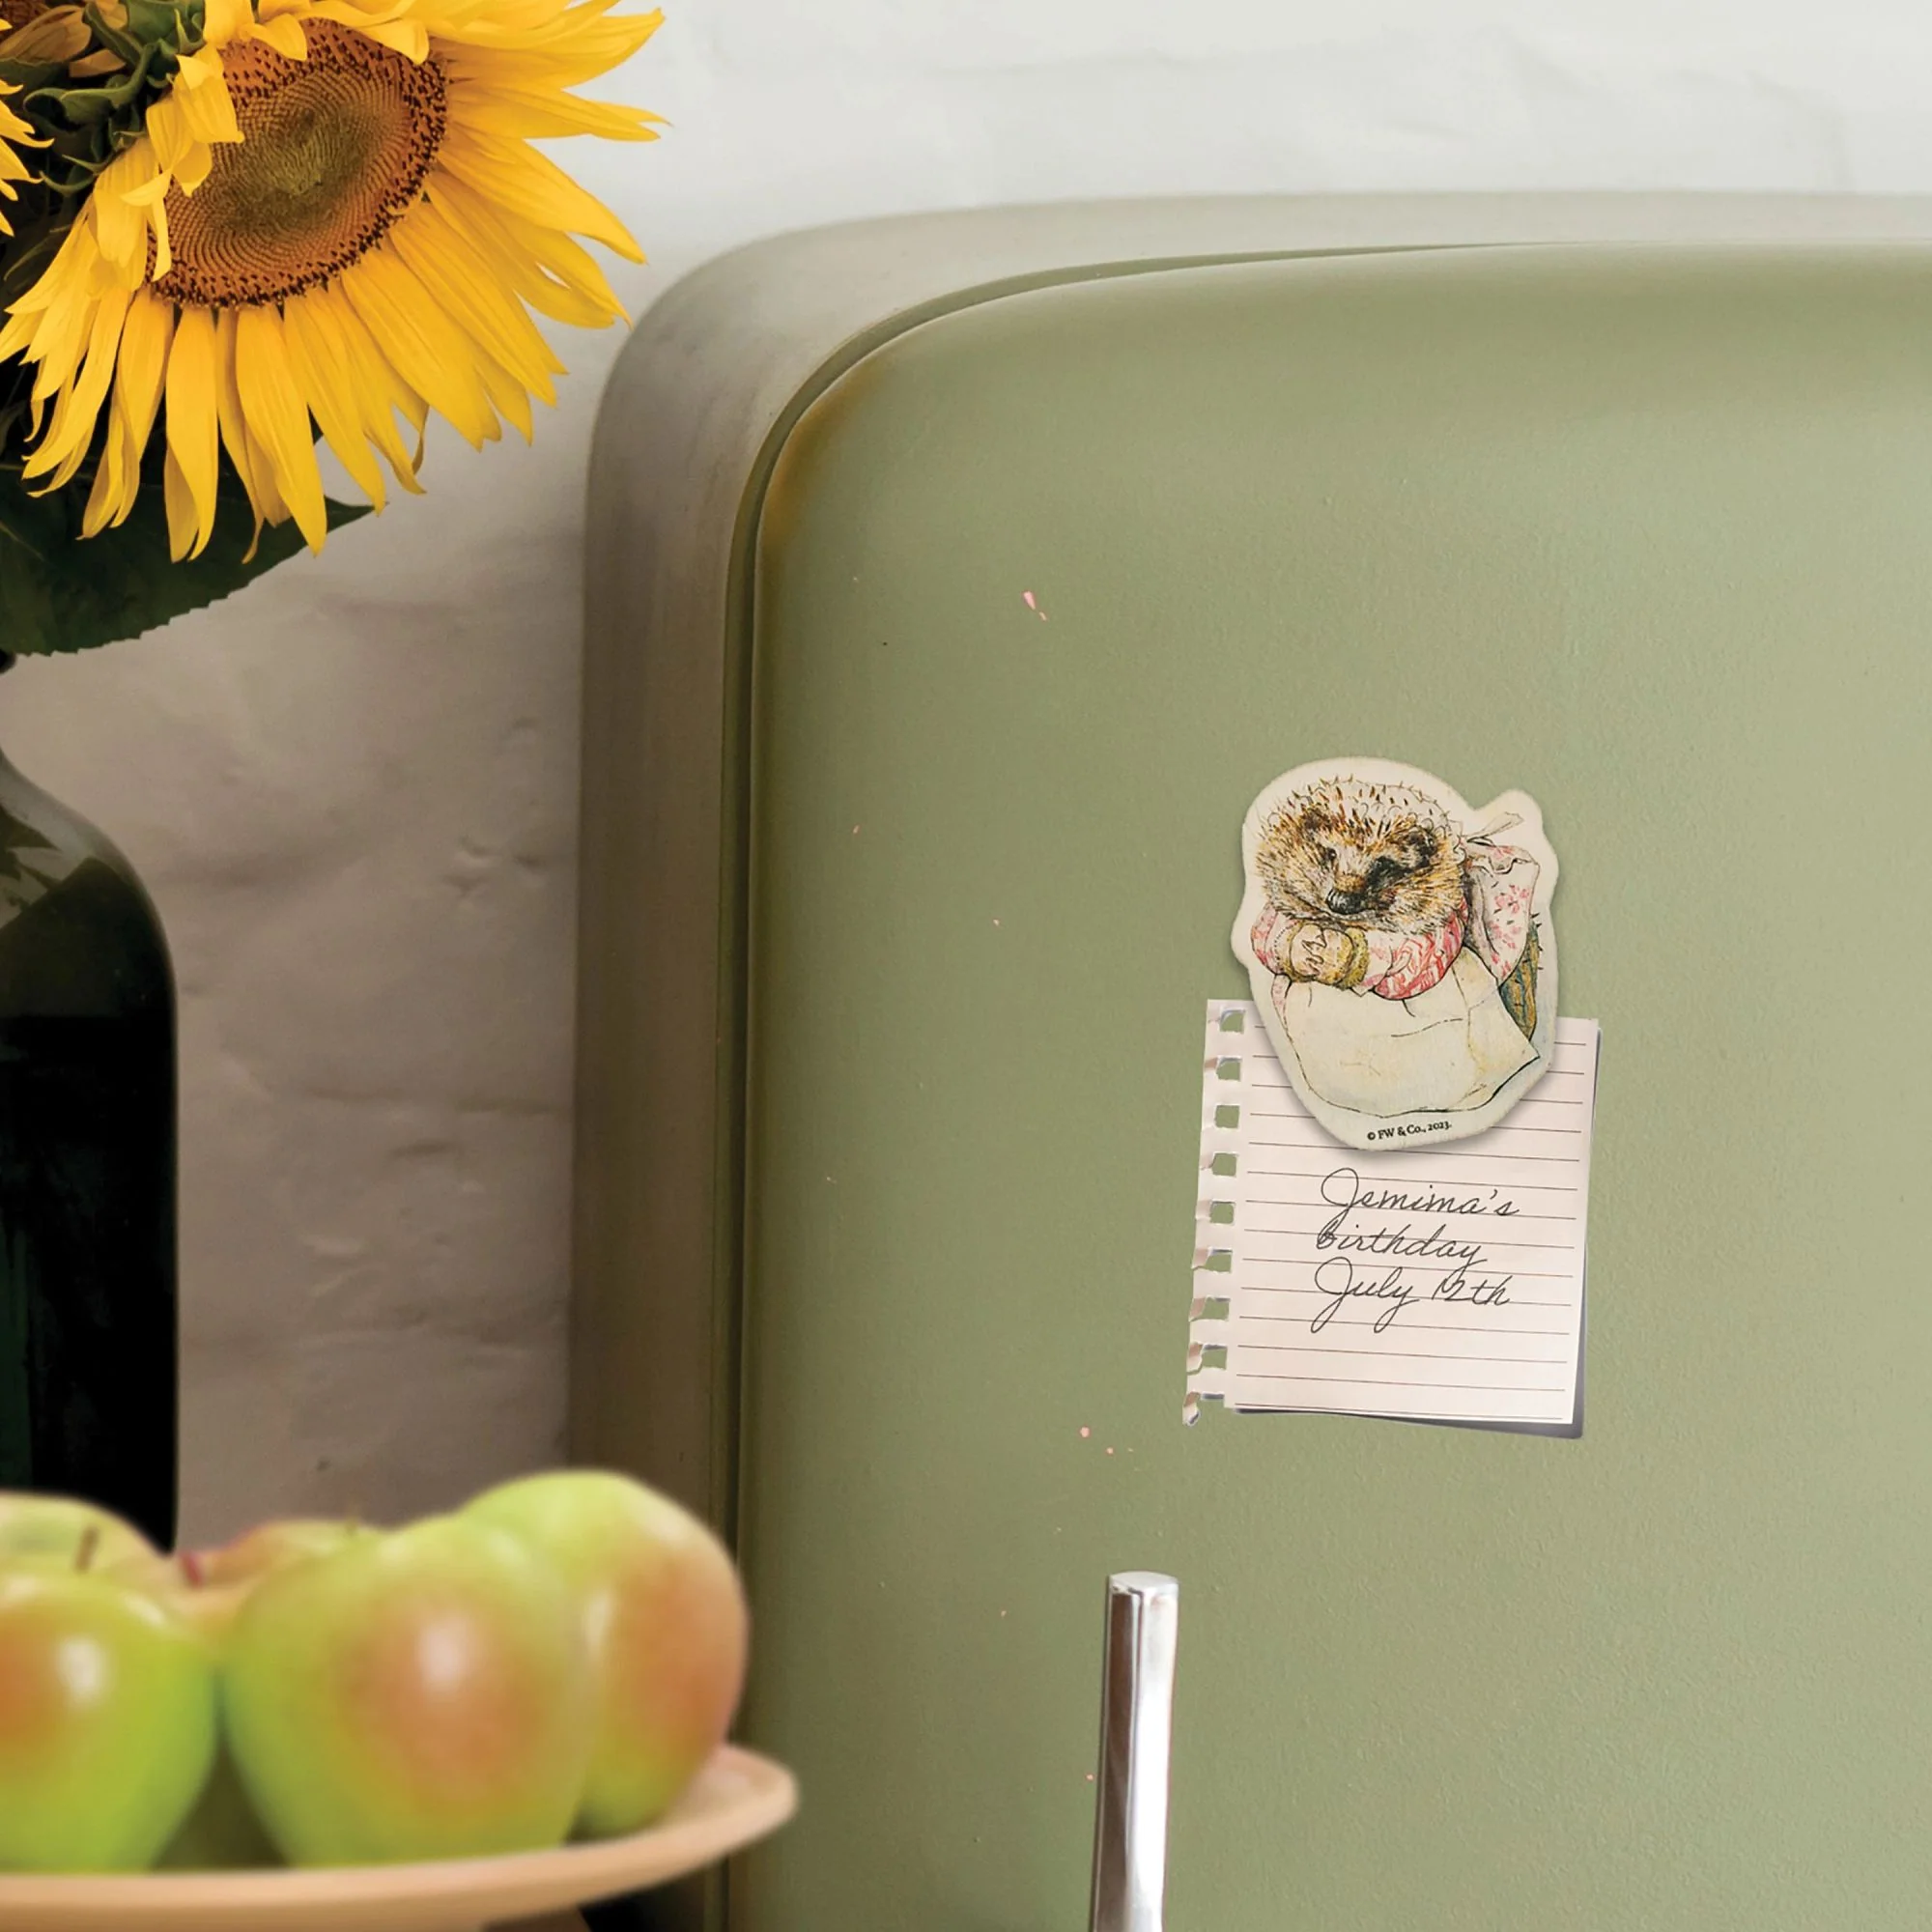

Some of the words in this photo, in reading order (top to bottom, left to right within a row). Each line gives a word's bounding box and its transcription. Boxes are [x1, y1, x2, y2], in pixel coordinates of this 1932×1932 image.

[1378, 1128, 1395, 1140] FW
[1397, 1126, 1406, 1137] &
[1406, 1124, 1427, 1135] Co.,
[1316, 1219, 1488, 1293] birthday
[1310, 1256, 1420, 1334] July
[1431, 1274, 1514, 1306] 12th
